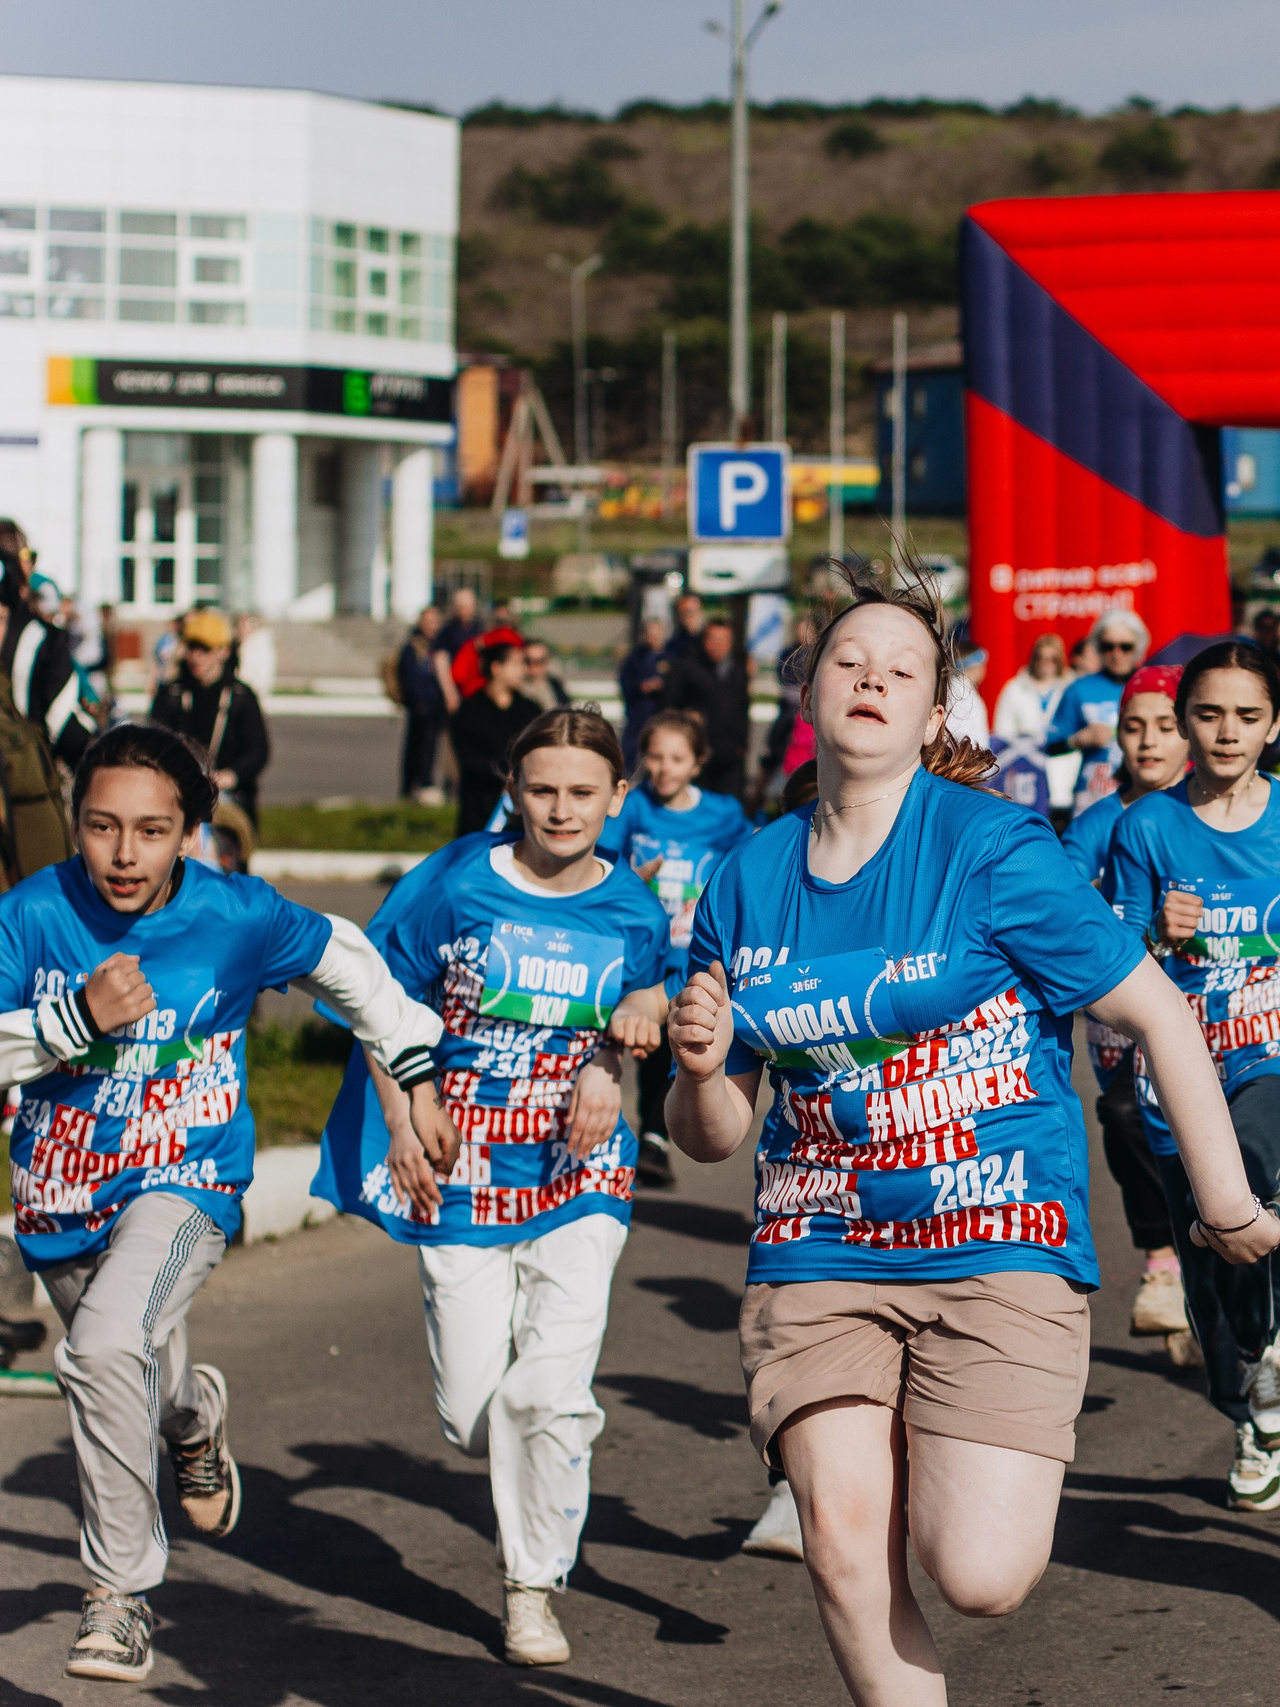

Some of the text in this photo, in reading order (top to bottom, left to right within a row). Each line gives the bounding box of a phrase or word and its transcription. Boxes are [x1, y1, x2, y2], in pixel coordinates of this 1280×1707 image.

[719, 461, 769, 531] P
[517, 955, 589, 997] 10100
[750, 973, 772, 987] ПСБ
[764, 996, 860, 1046] 10041
[866, 1053, 1040, 1143] #МОМЕНТ
[930, 1150, 1029, 1215] 2024
